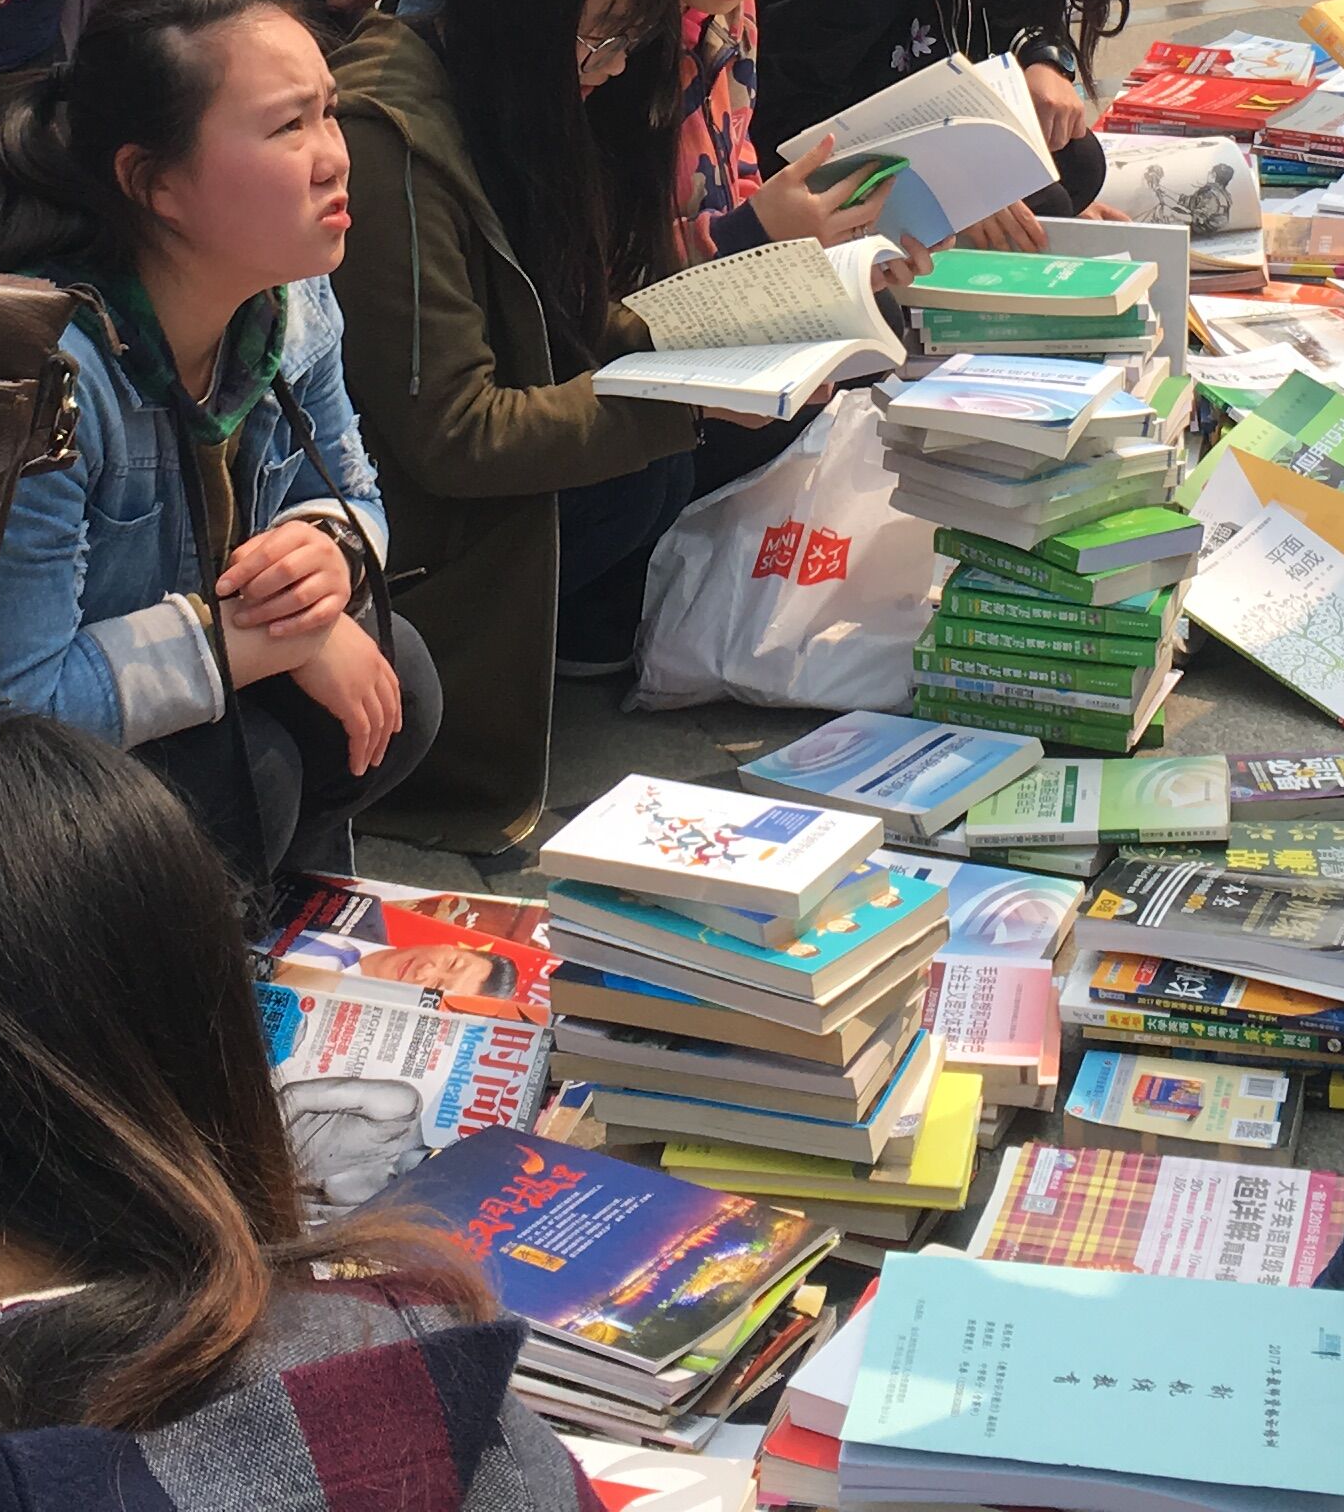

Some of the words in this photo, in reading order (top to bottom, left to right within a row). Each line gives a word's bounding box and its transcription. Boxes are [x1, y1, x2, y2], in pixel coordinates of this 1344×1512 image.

[1264, 532, 1306, 569] 平面
[1284, 548, 1327, 586] 构成
[361, 1006, 382, 1046] FIGHT
[457, 1024, 537, 1138] 时尚
[1224, 1175, 1270, 1242] 超详解
[1052, 1370, 1235, 1401] 新航线教育
